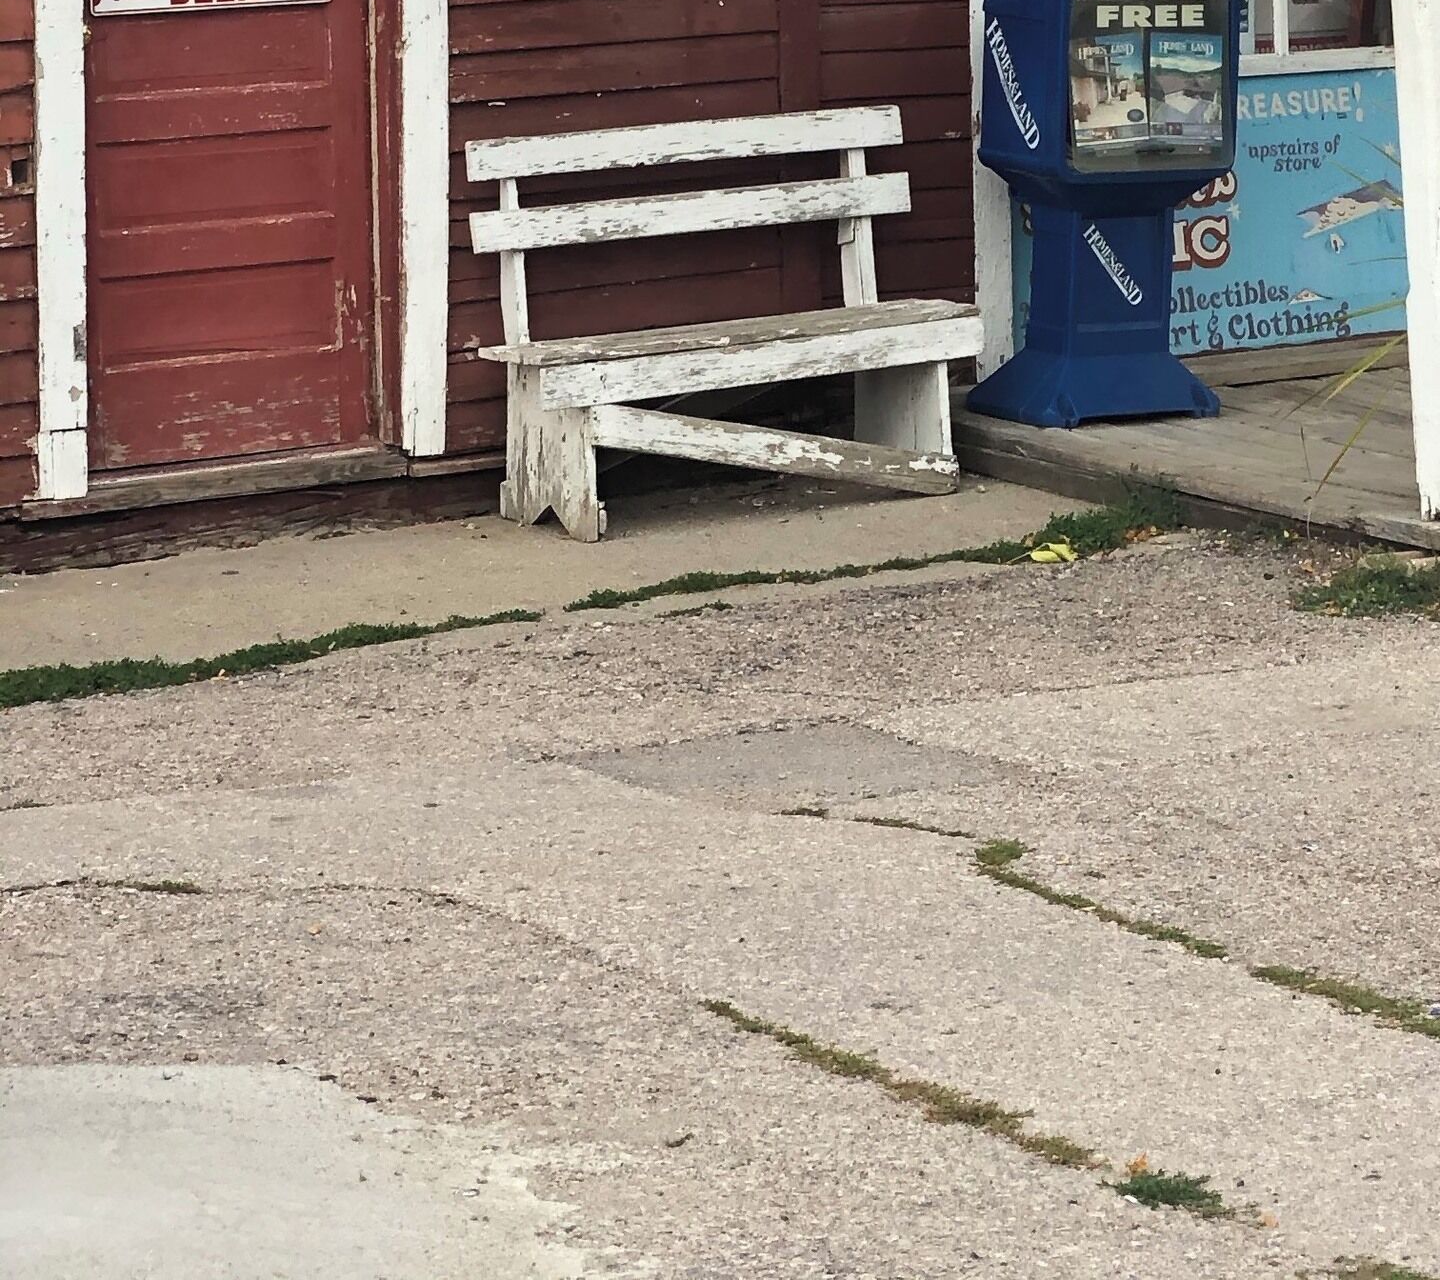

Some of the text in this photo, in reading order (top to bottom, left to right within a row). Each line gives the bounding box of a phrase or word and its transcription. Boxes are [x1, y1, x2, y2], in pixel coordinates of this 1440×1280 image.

[1096, 4, 1205, 28] FREE
[1323, 133, 1342, 156] of
[1206, 309, 1225, 350] &
[1227, 300, 1351, 341] Clothing
